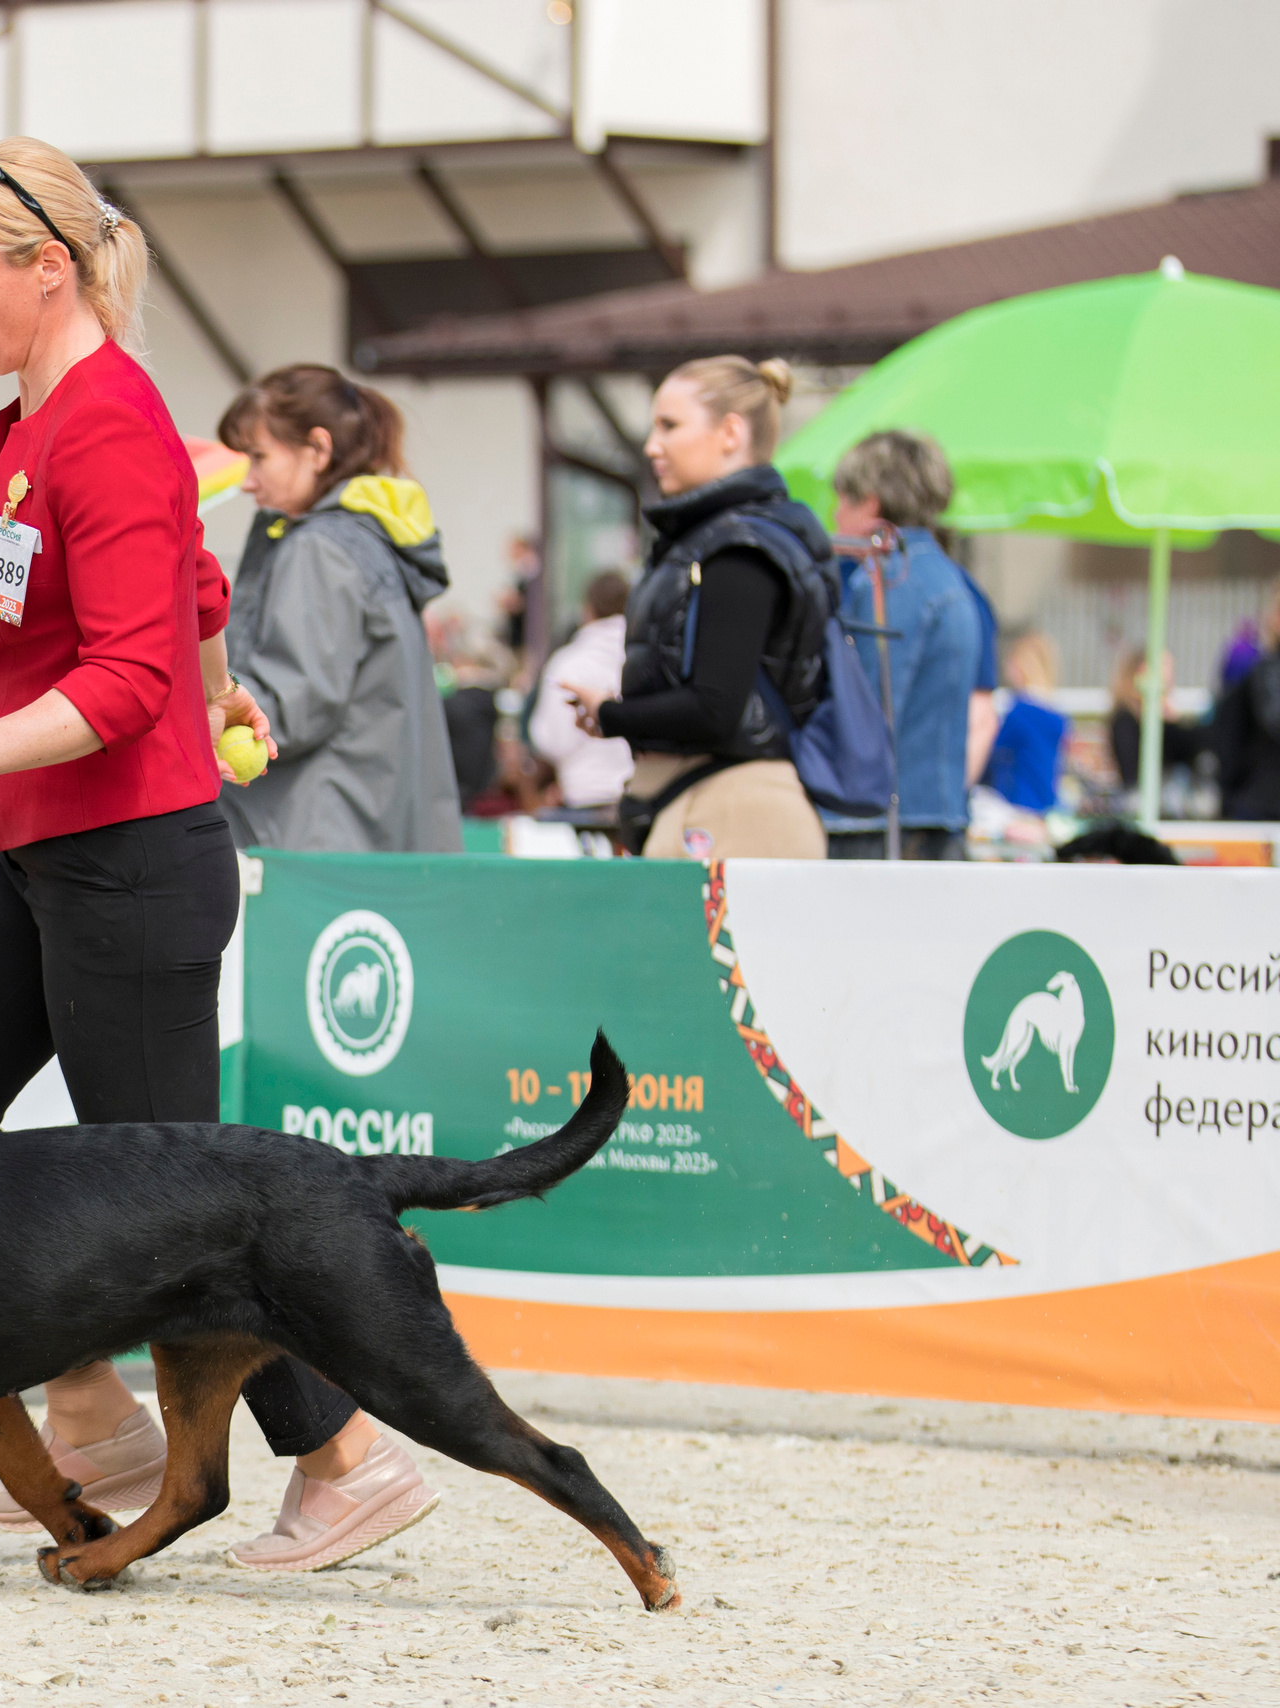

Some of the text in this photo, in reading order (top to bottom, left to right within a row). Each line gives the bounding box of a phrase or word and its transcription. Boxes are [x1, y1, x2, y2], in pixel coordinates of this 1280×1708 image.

[1148, 949, 1280, 992] Россий
[506, 1068, 541, 1106] 10
[626, 1073, 704, 1112] ЮНЯ
[282, 1104, 434, 1156] РОССИЯ
[608, 1147, 670, 1174] Москвы
